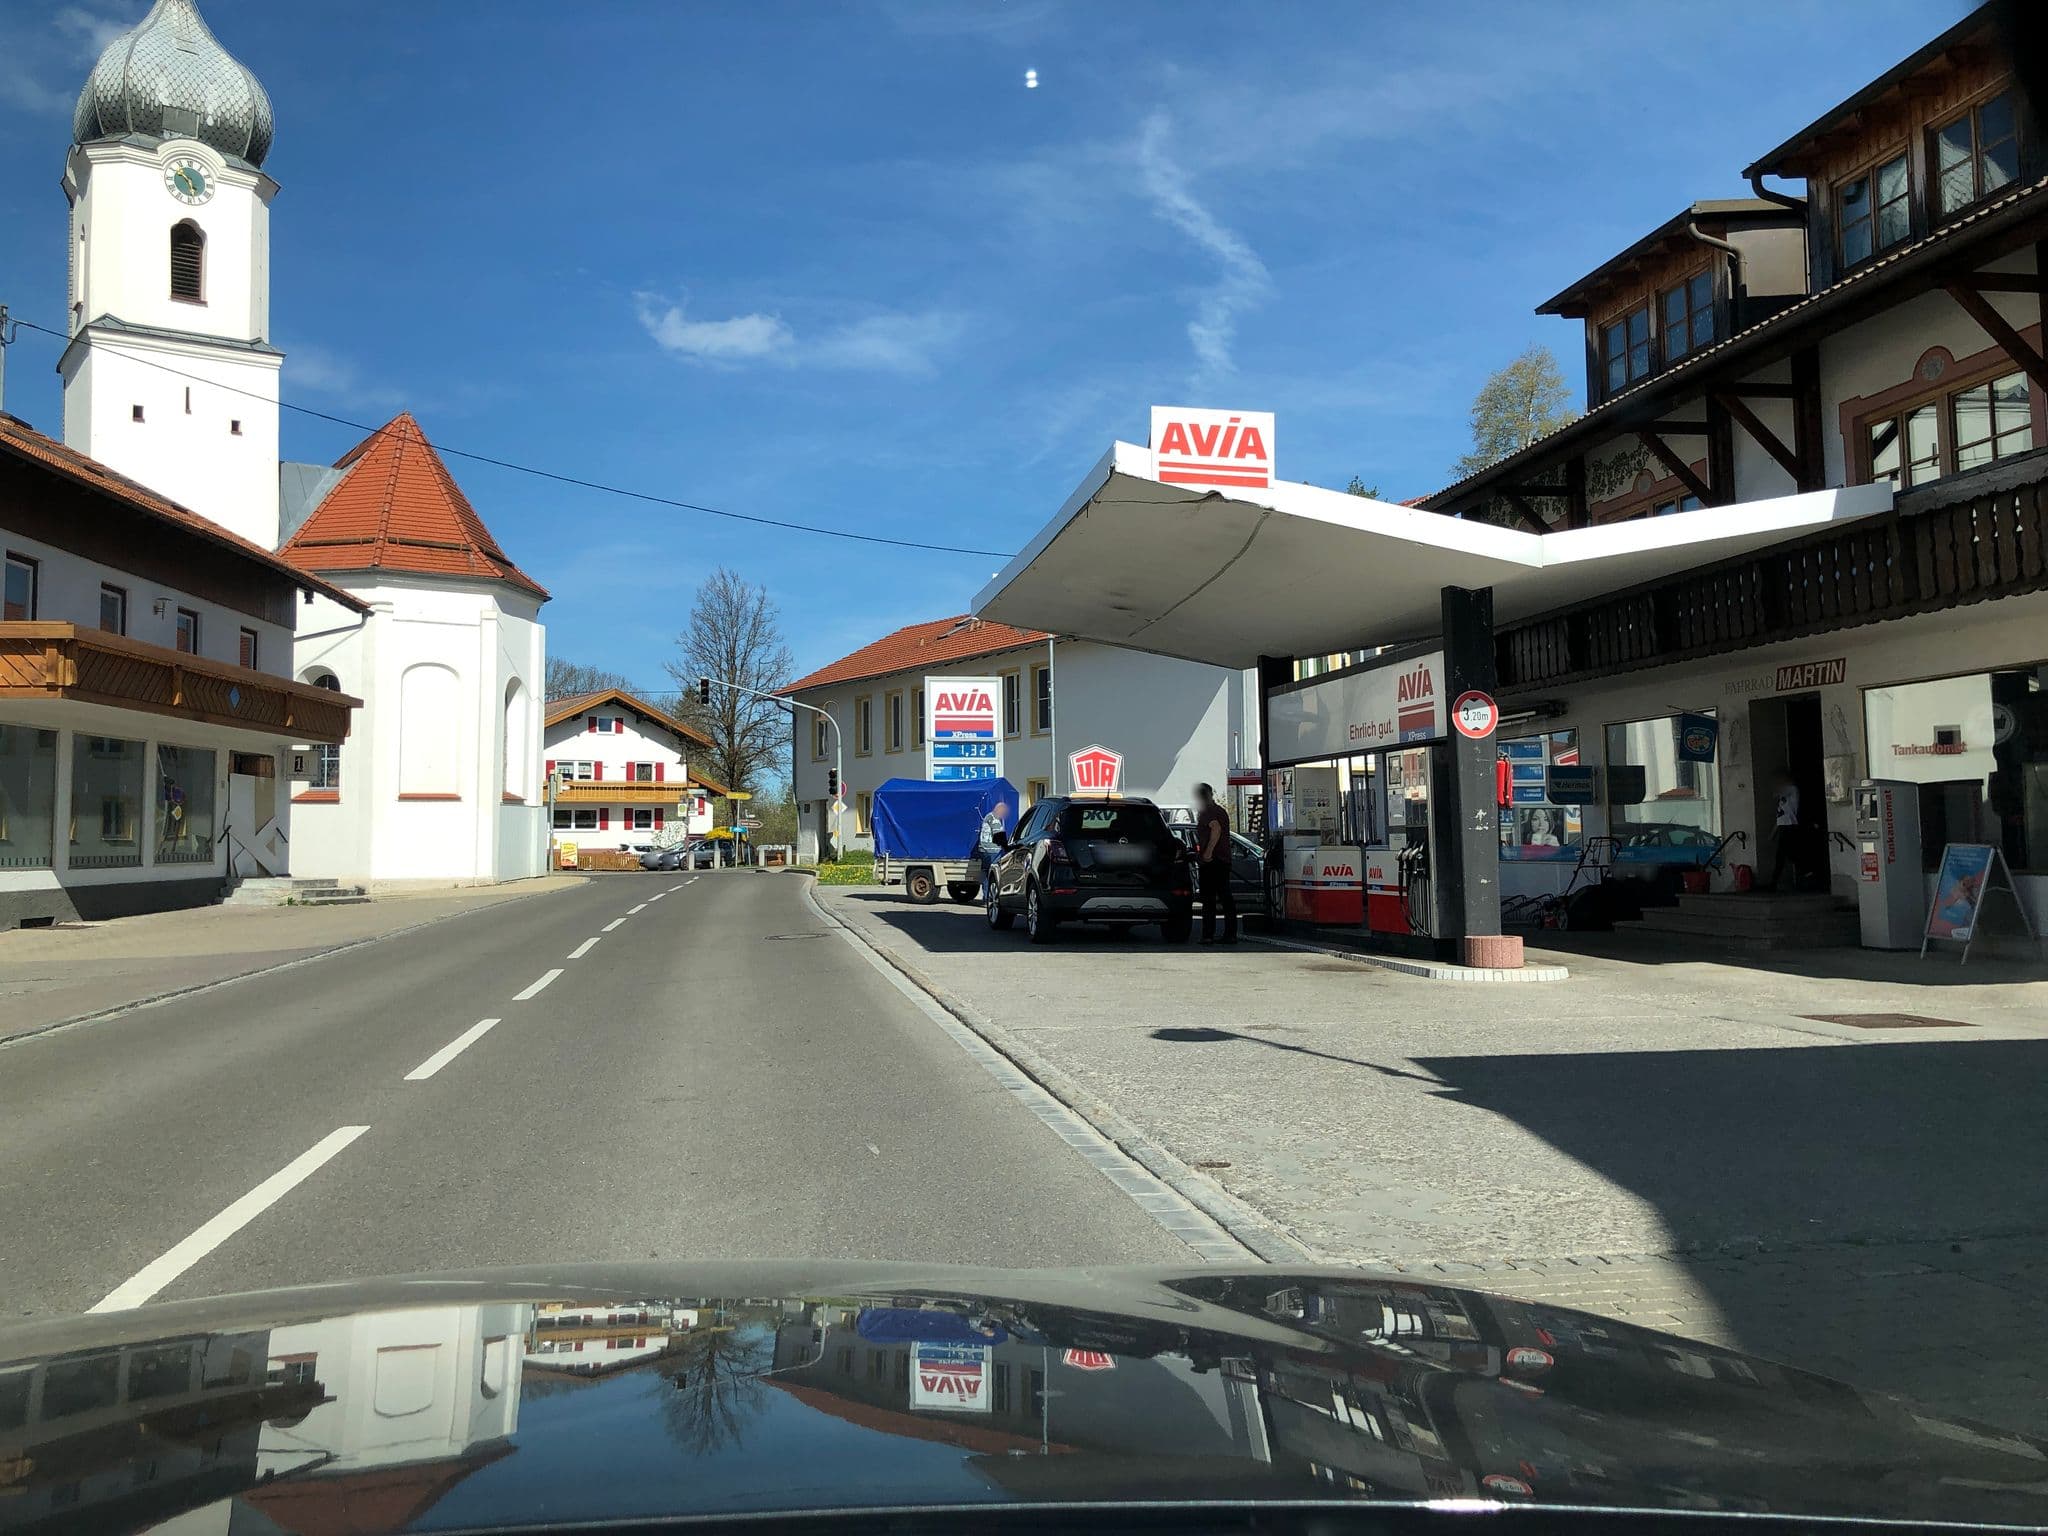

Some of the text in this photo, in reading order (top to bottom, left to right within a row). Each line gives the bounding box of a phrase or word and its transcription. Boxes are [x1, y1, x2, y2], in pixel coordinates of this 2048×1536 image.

[1778, 660, 1845, 690] MARTIN
[1350, 718, 1394, 740] Ehrlich gut.
[1891, 741, 1968, 756] Tankautomat
[1076, 751, 1118, 787] UTA
[1884, 790, 1896, 864] Tankautomat
